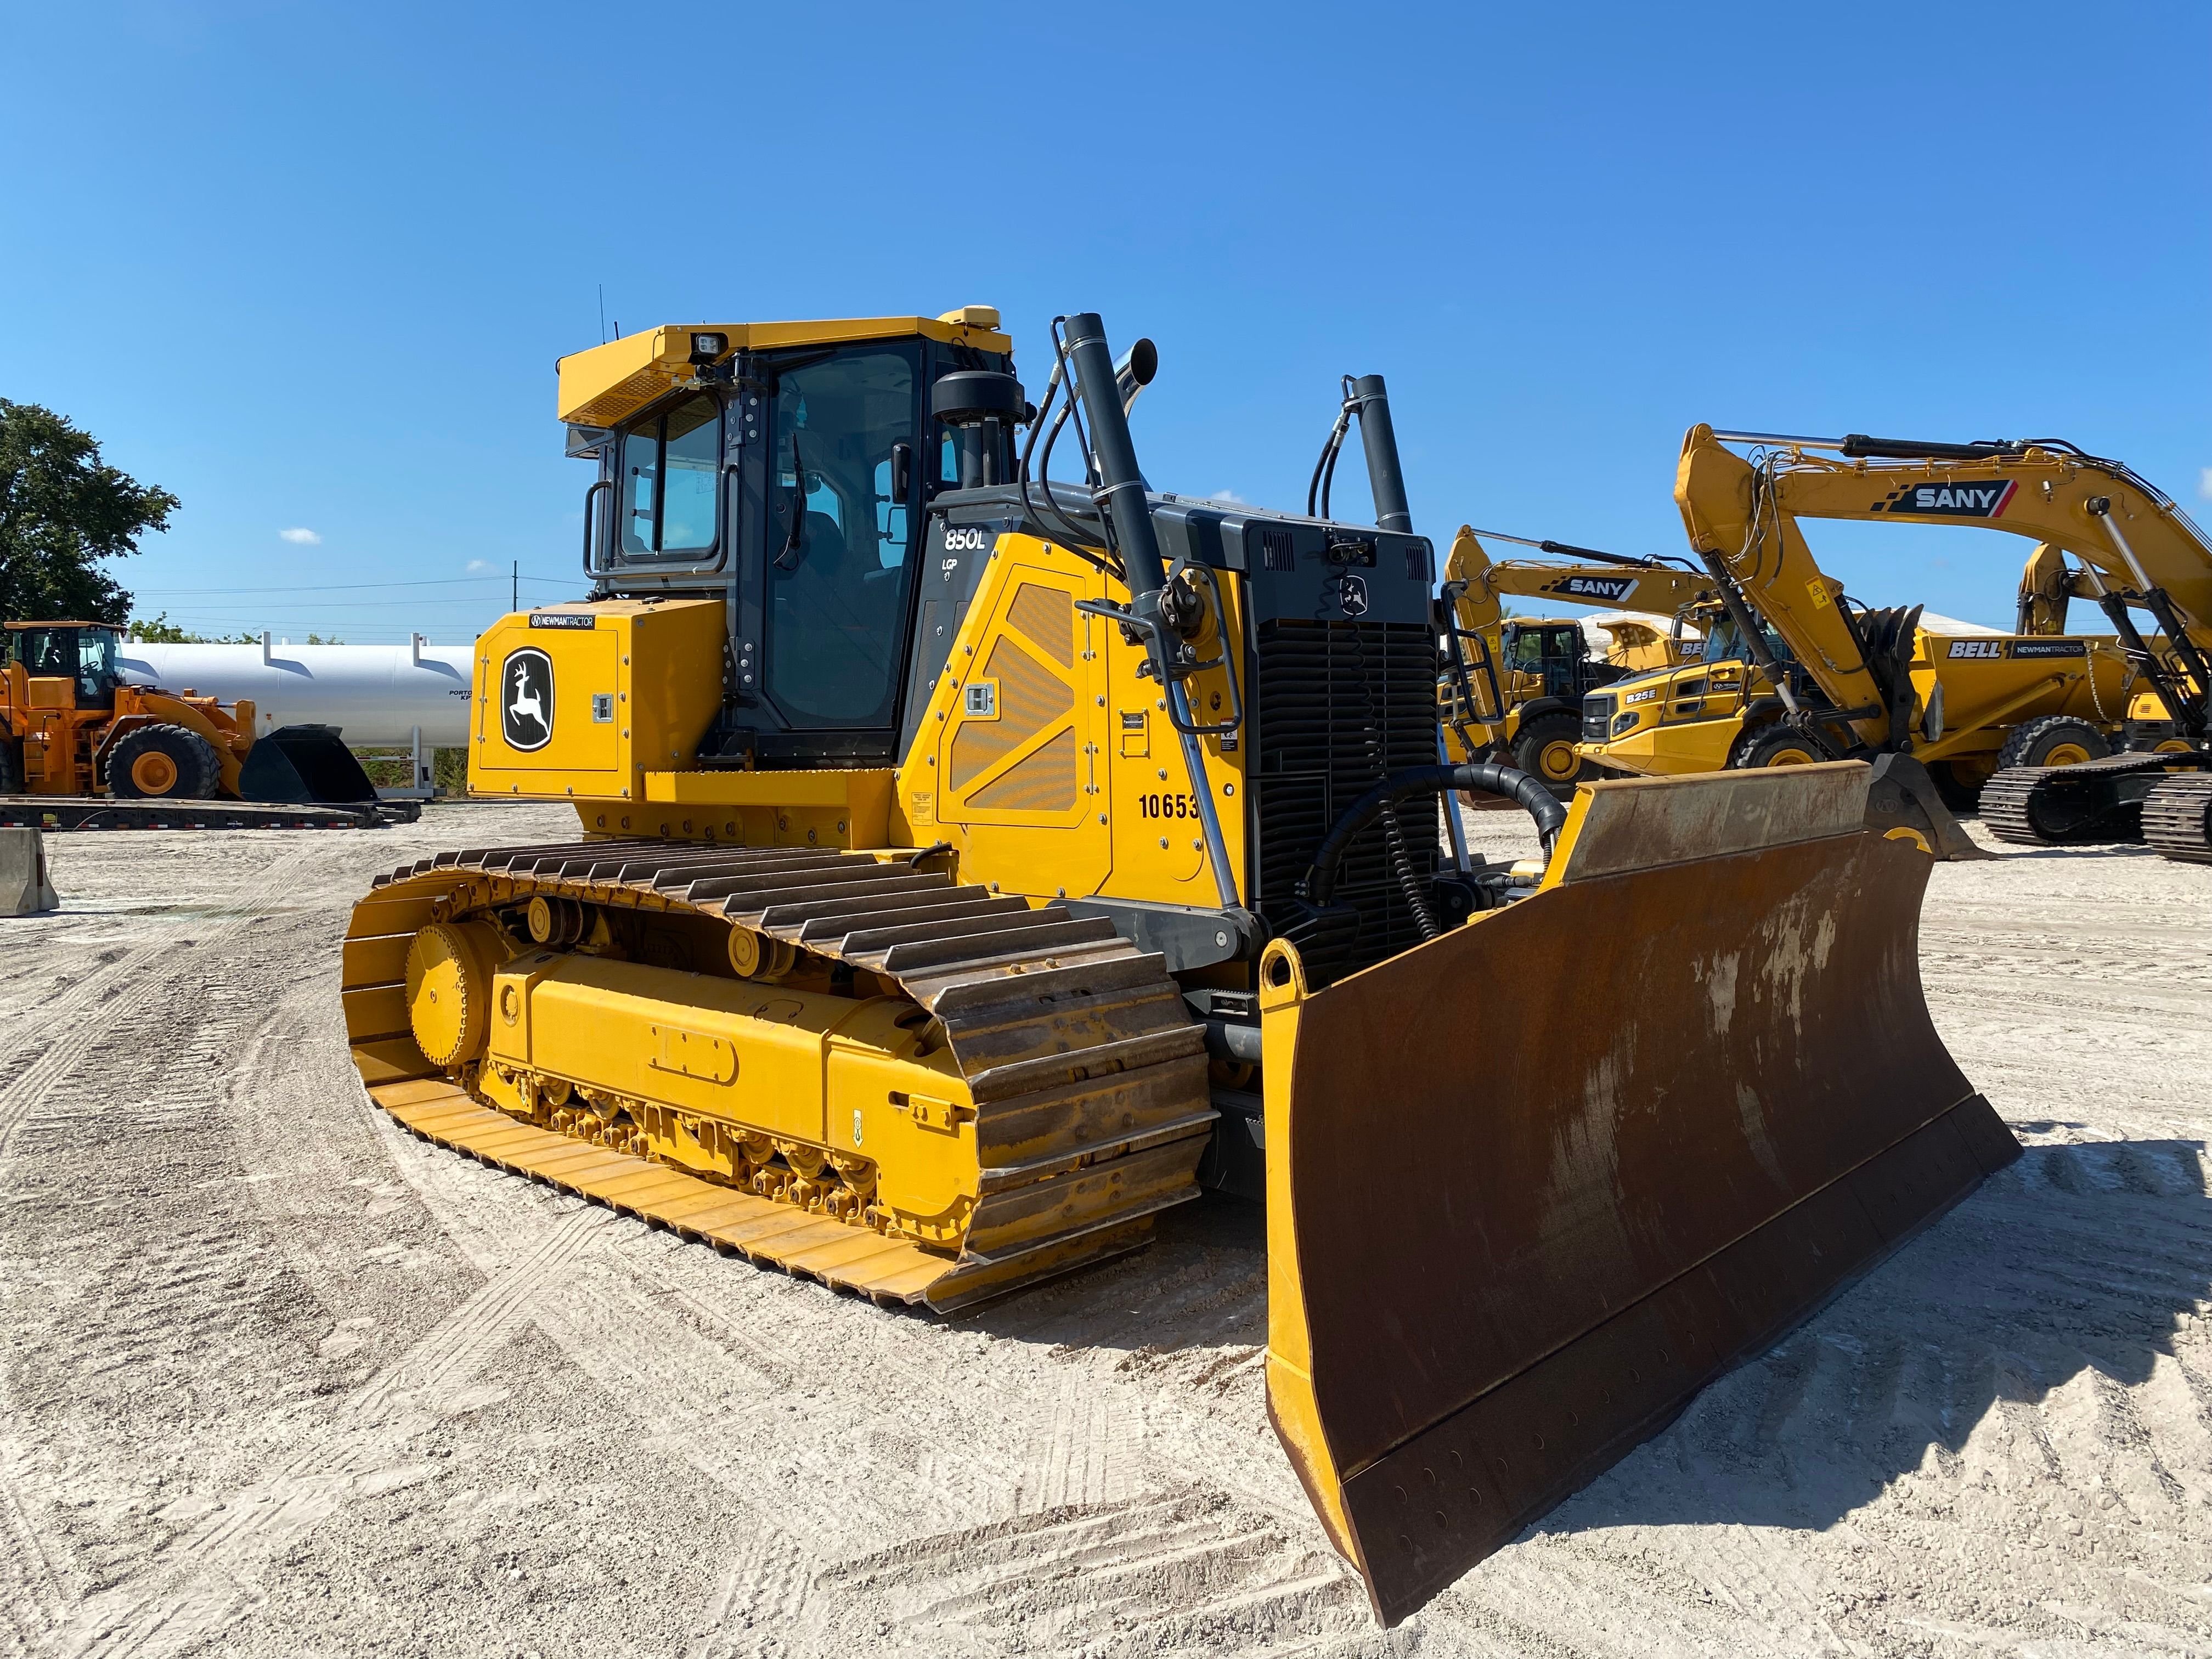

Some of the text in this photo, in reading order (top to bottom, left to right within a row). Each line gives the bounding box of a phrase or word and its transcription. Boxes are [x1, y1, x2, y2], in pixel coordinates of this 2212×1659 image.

[1916, 488, 1996, 508] SANY
[945, 528, 985, 550] 850L
[941, 558, 957, 570] LGP
[1570, 579, 1624, 595] SANY
[1948, 642, 2002, 658] BELL
[1626, 689, 1656, 704] B25E
[1139, 793, 1199, 819] 10653
